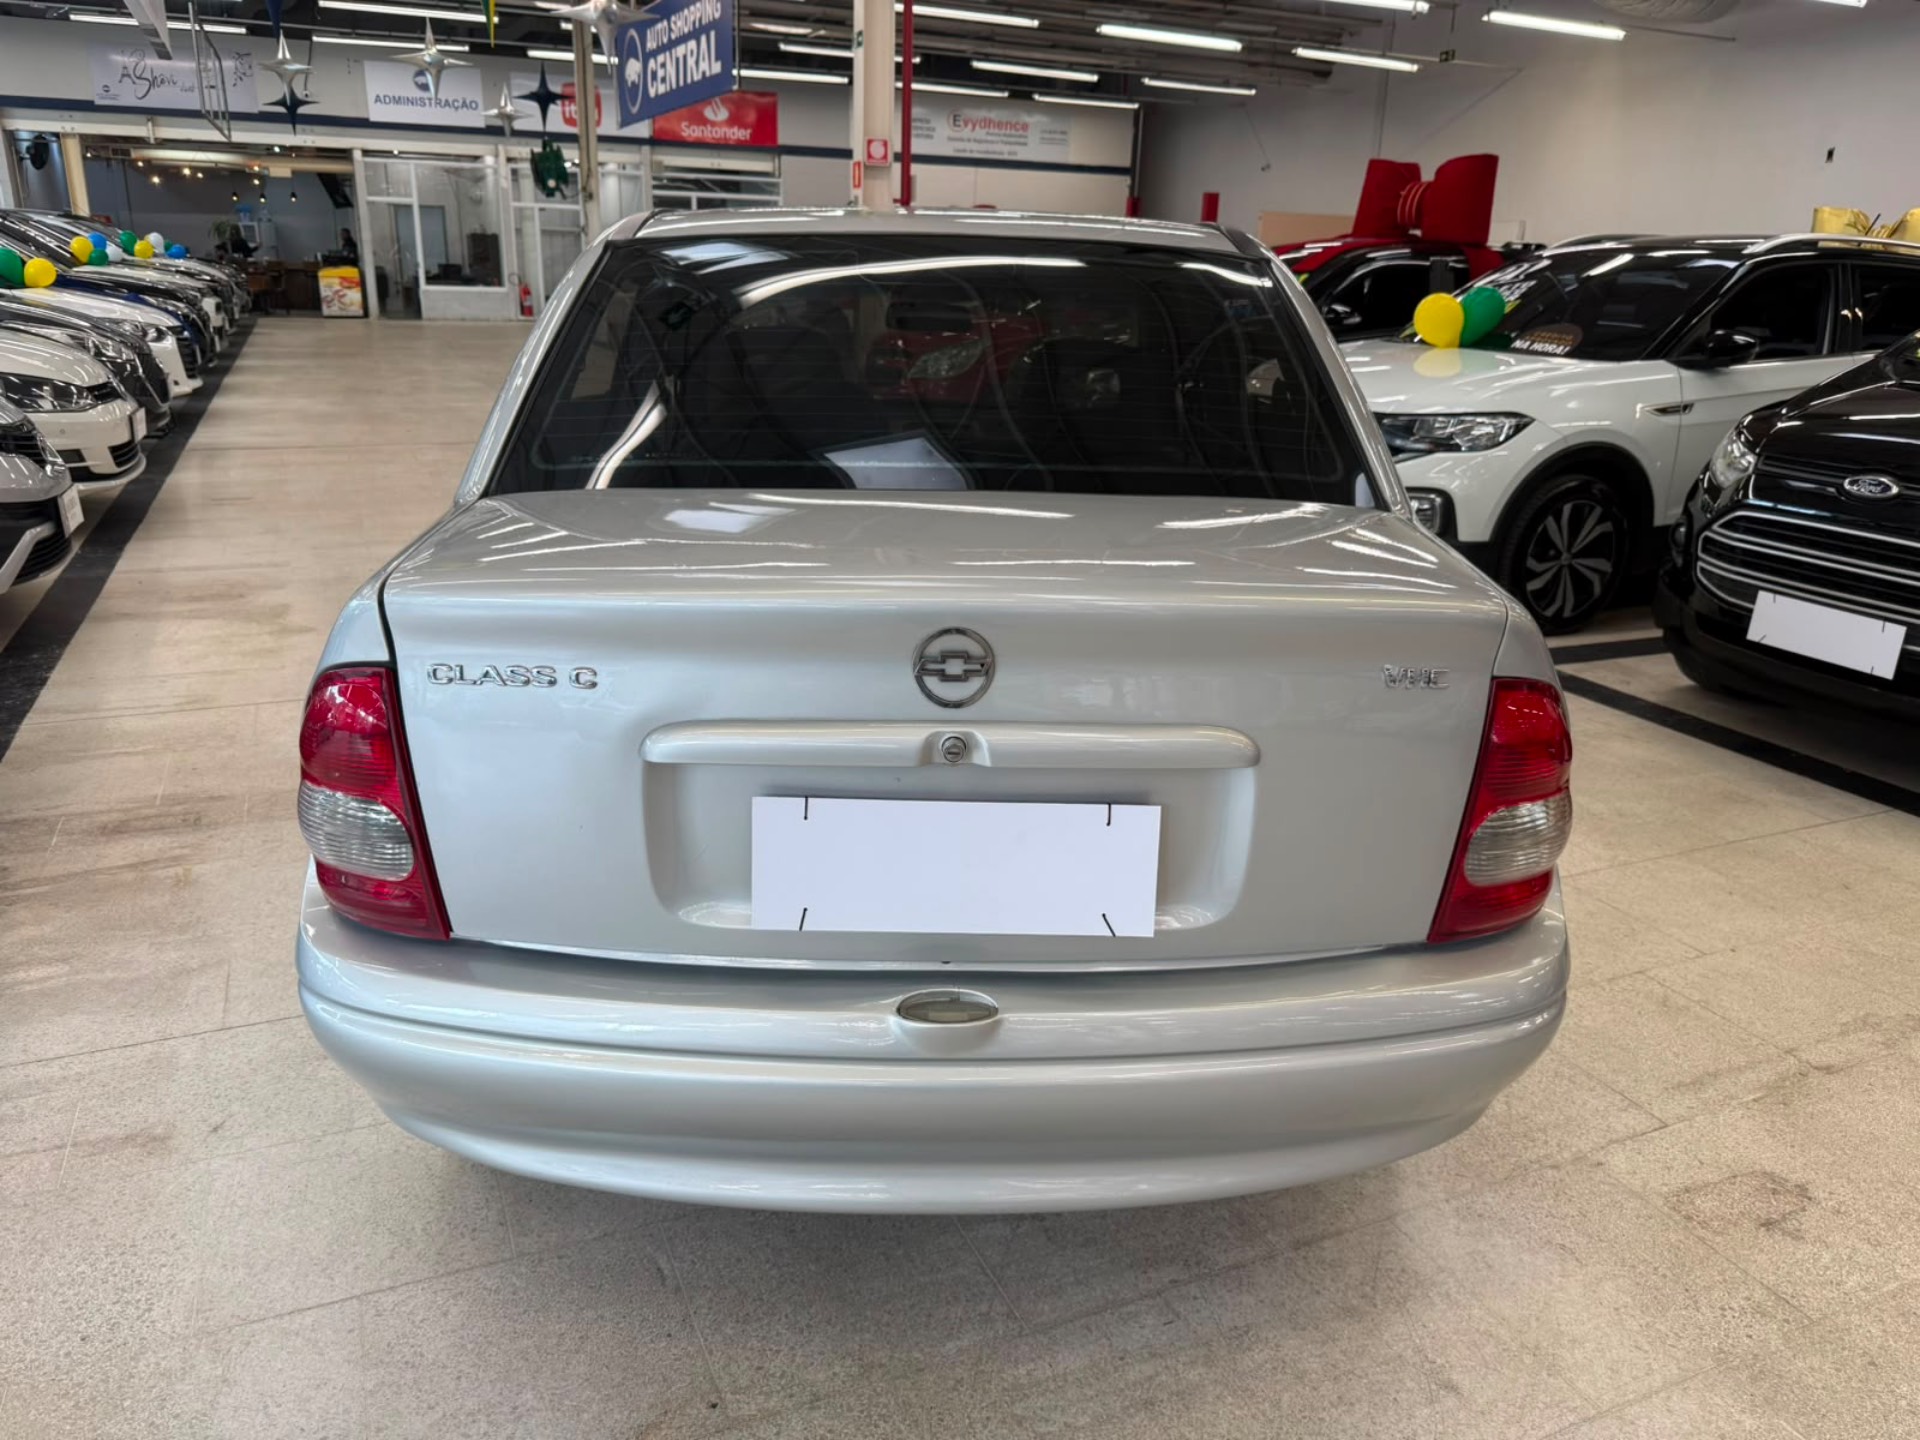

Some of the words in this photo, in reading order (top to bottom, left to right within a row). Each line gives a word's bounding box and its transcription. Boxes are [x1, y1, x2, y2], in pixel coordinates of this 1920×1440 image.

[646, 19, 669, 52] AUTO
[670, 0, 721, 40] SHOPPING
[647, 30, 722, 98] CENTRAL
[374, 94, 479, 112] ADMINISTRAÇÃO
[681, 121, 753, 140] Santander
[952, 114, 1029, 133] Evydhence
[1510, 339, 1531, 350] NA
[1529, 341, 1571, 355] HORA!
[427, 663, 558, 688] CLASS
[569, 666, 598, 689] C
